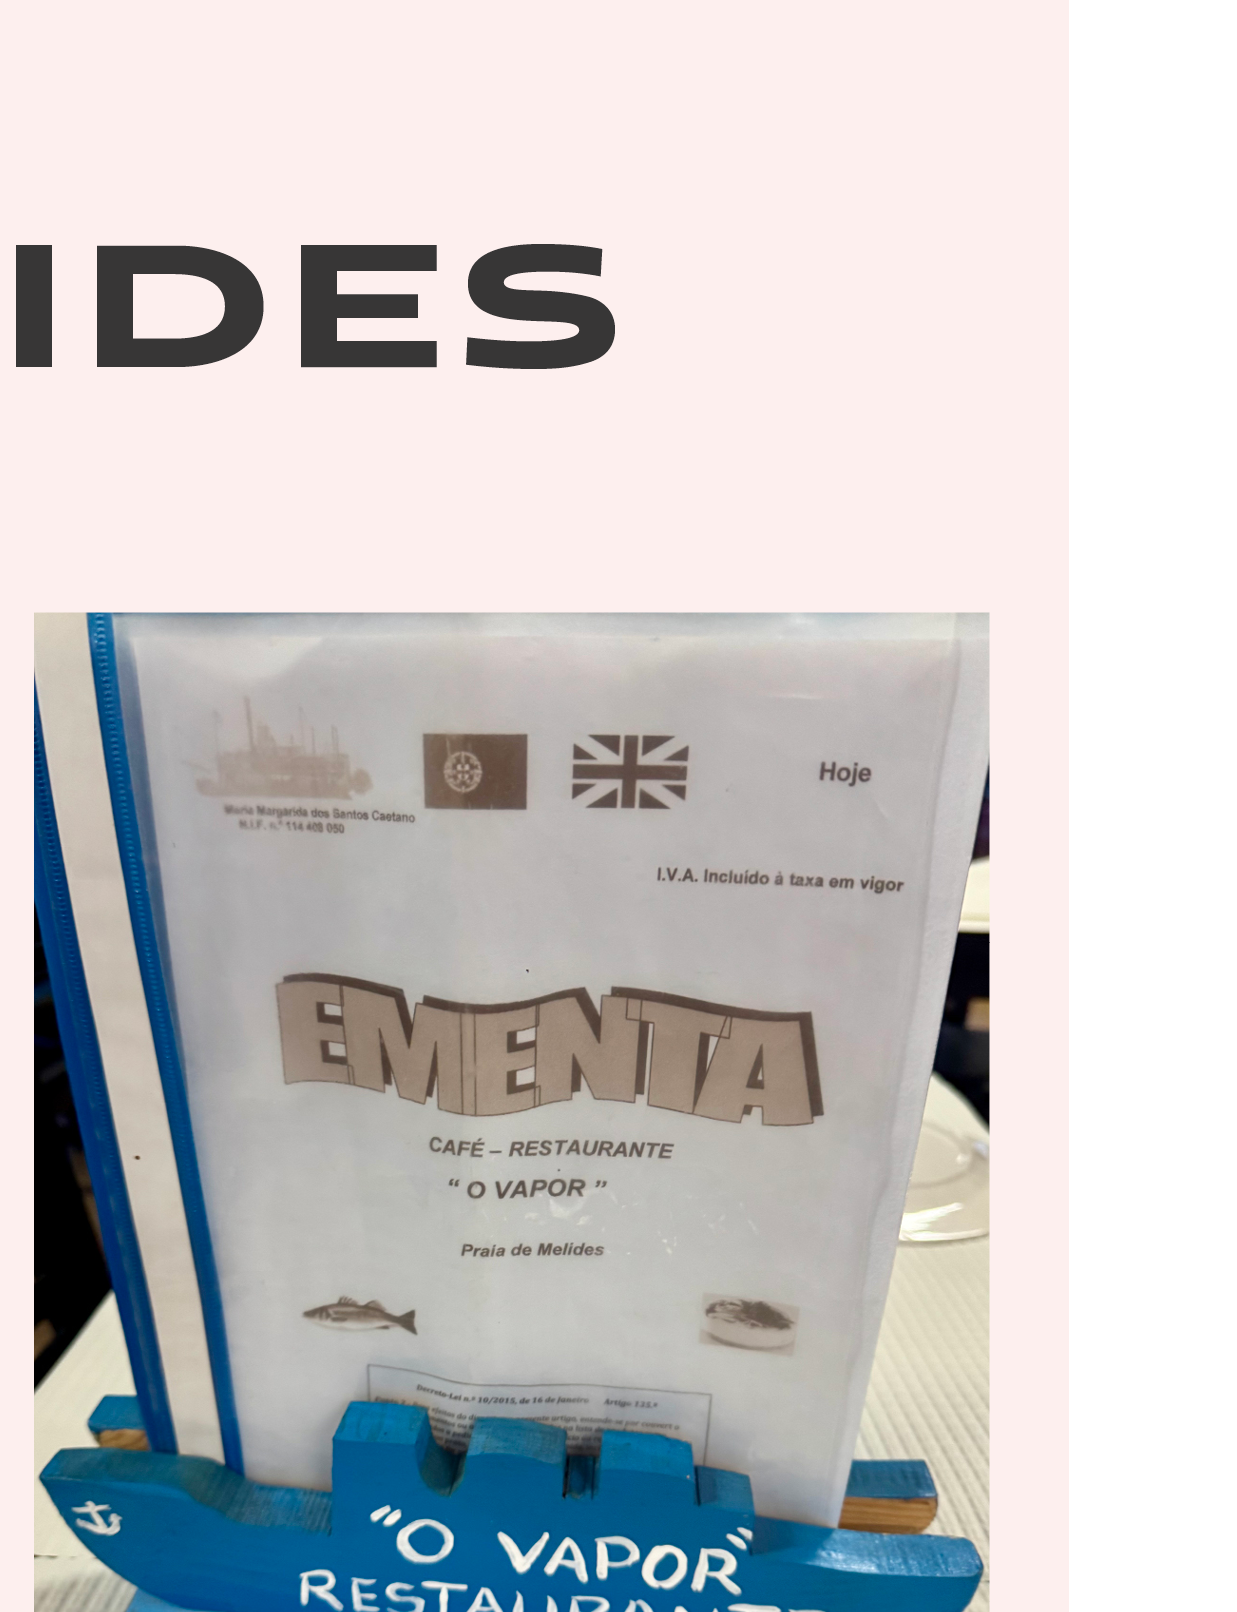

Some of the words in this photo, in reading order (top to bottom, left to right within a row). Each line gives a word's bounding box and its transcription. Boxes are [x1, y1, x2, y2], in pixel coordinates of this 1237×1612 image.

[818, 761, 872, 787] Hoje
[257, 805, 308, 819] Margarida
[311, 808, 329, 818] dos
[333, 808, 369, 821] Santos
[372, 811, 416, 823] Caetano
[286, 822, 304, 832] 114
[326, 823, 345, 834] 050
[657, 867, 698, 883] I.V.A.
[703, 868, 769, 885] Incluído
[789, 873, 824, 887] taxa
[828, 876, 854, 889] em
[860, 876, 904, 894] vigor
[275, 972, 824, 1125] EMENTA
[429, 1136, 485, 1158] CAFÉ
[508, 1139, 675, 1159] RESTAURANTE
[494, 1178, 586, 1199] VAPOR
[460, 1243, 505, 1258] Praia
[511, 1243, 532, 1257] de
[537, 1242, 605, 1257] Melides
[416, 1384, 462, 1402] Decreto-Lei
[478, 1396, 517, 1405] 10/2015,
[519, 1396, 530, 1404] de
[532, 1396, 543, 1404] 16
[545, 1396, 555, 1404] de
[604, 1398, 632, 1408] Artigo
